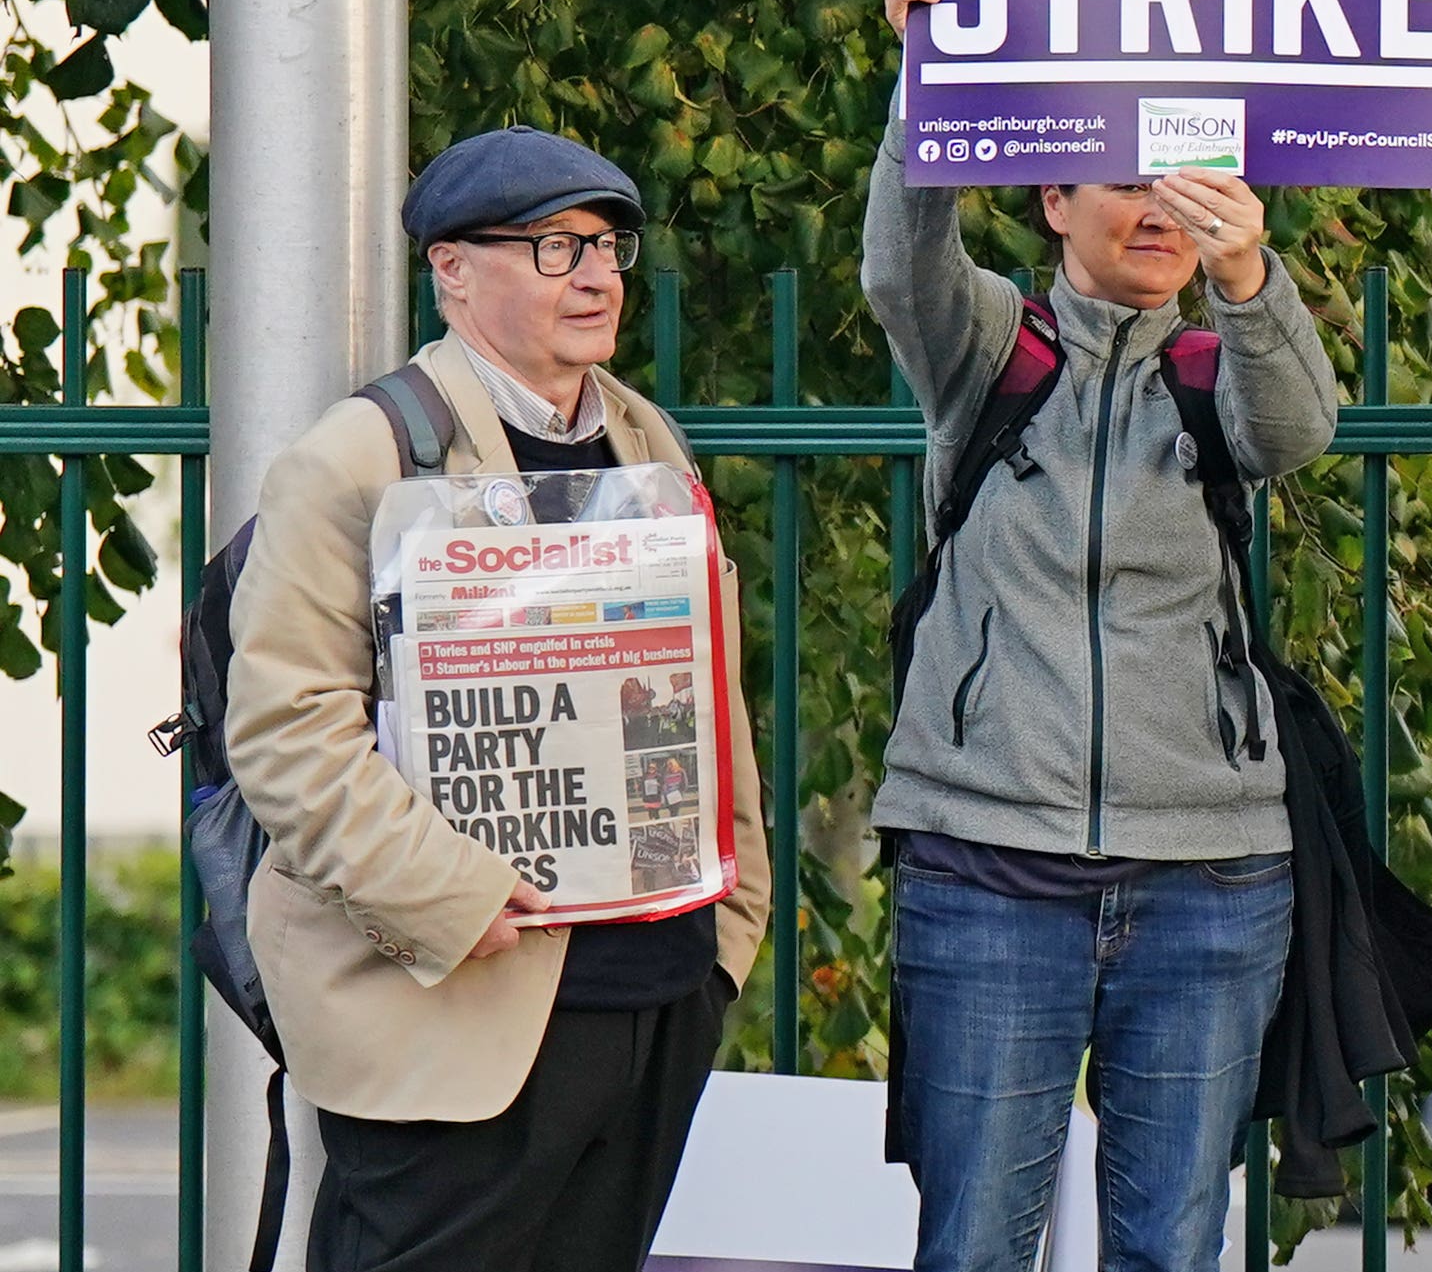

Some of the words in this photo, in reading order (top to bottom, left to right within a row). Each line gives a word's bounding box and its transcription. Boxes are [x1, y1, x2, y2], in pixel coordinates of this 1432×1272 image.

[919, 116, 1105, 135] unison-edinburgh.org.uk
[1149, 117, 1235, 136] UNISON
[1004, 138, 1105, 156] @unisonedin
[1150, 143, 1171, 152] City
[1174, 142, 1187, 154] of
[1188, 143, 1240, 154] Edinburgh
[419, 555, 441, 572] the
[446, 534, 633, 573] Socialist
[451, 585, 515, 600] Militant
[434, 644, 468, 657] Tories
[470, 642, 491, 655] and
[520, 638, 567, 654] engulfed
[584, 635, 615, 649] crisis
[493, 659, 531, 672] Labour
[547, 655, 566, 668] the
[569, 652, 605, 670] pocket
[609, 652, 621, 664] of
[623, 650, 640, 664] big
[643, 647, 691, 661] business
[425, 686, 540, 728] BUILD
[551, 683, 577, 721] A
[428, 727, 546, 772] PARTY
[431, 774, 510, 816] FOR
[512, 767, 587, 809] THE
